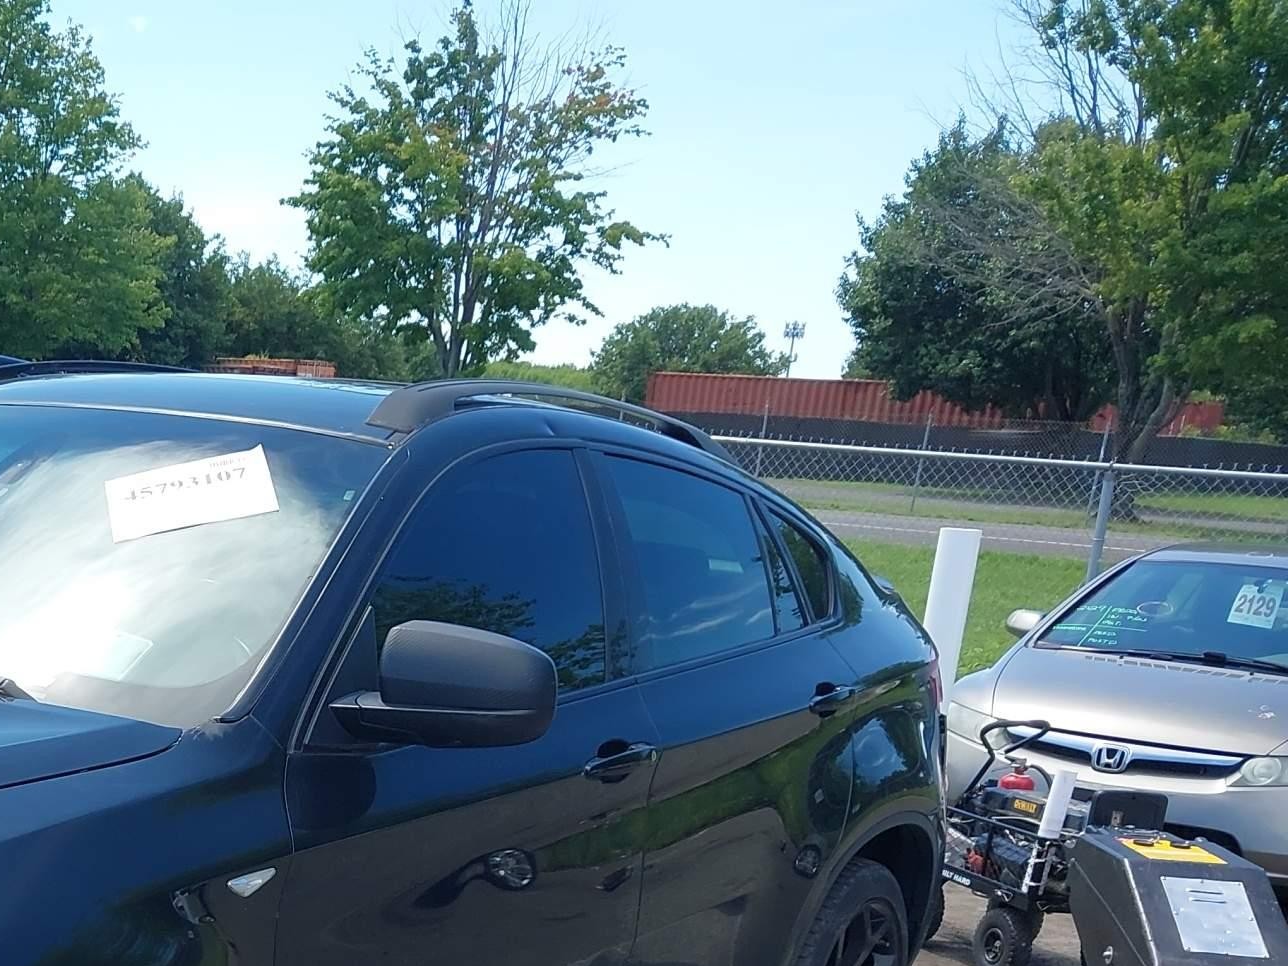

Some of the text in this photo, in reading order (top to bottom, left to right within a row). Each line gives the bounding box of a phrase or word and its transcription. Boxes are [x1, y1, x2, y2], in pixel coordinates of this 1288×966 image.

[123, 466, 246, 501] 45793107
[1234, 593, 1277, 617] 2129
[953, 873, 971, 886] HARD
